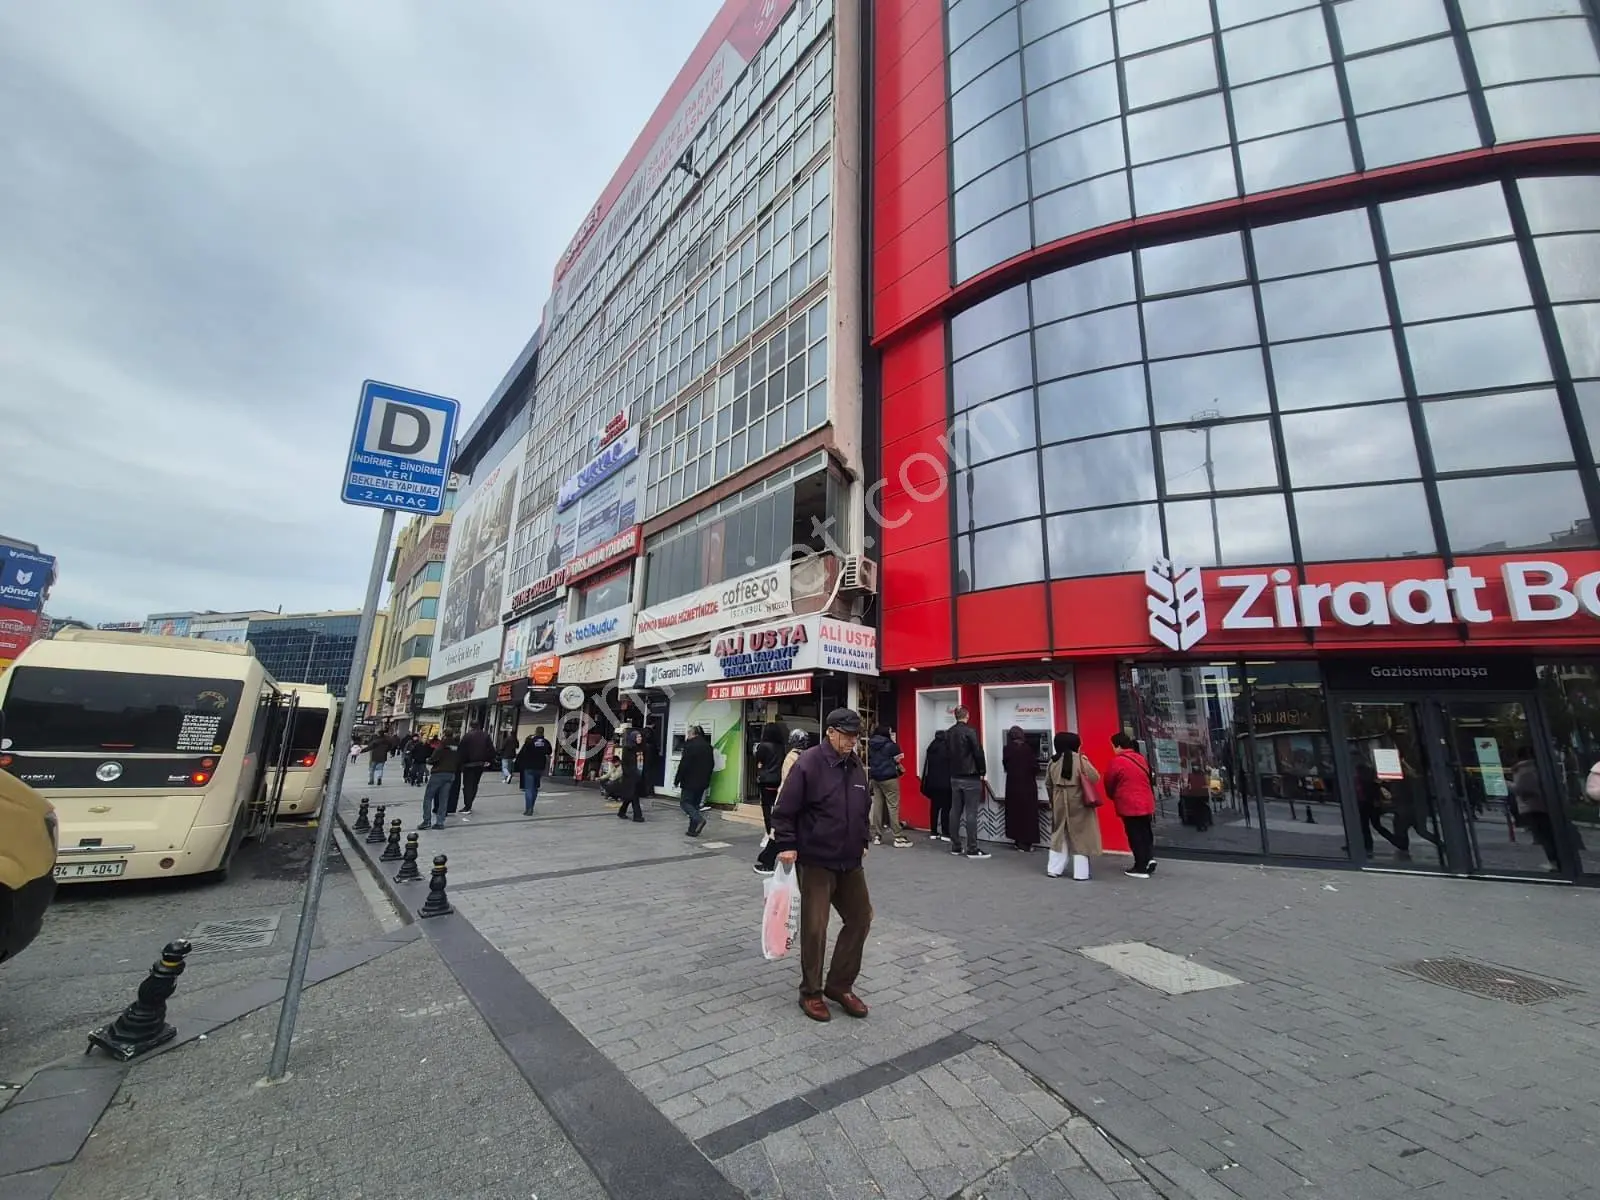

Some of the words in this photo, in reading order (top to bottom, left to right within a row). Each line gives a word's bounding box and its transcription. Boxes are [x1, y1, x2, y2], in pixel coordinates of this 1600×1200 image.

[378, 402, 430, 454] D
[353, 452, 392, 468] İNDİRME
[400, 461, 444, 476] BİNDİRME
[384, 469, 412, 480] YERİ
[352, 475, 393, 489] BEKLEME
[396, 482, 438, 496] YAPILMAZ
[384, 494, 426, 508] ARAÇ
[0, 585, 38, 599] yönder
[722, 580, 759, 605] coffee
[761, 576, 778, 599] go
[1218, 566, 1494, 630] Ziraat
[714, 631, 745, 657] ALİ
[749, 624, 808, 651] USTA
[819, 625, 841, 641] ALİ
[846, 631, 877, 648] USTA
[720, 653, 752, 668] BURMA
[753, 646, 800, 663] KADAYIF
[823, 644, 847, 655] BURMA
[849, 648, 874, 660] KADAYIF
[658, 665, 681, 680] Garanti
[682, 660, 705, 676] BBVA
[724, 658, 793, 677] BAKLAVALARI
[827, 656, 871, 670] BAKLAVALARI
[1371, 665, 1488, 679] Gaziosmanpaşa
[774, 679, 807, 693] BAKLAVALARI
[54, 866, 67, 877] 34
[77, 865, 84, 875] M
[92, 863, 120, 874] 4041
